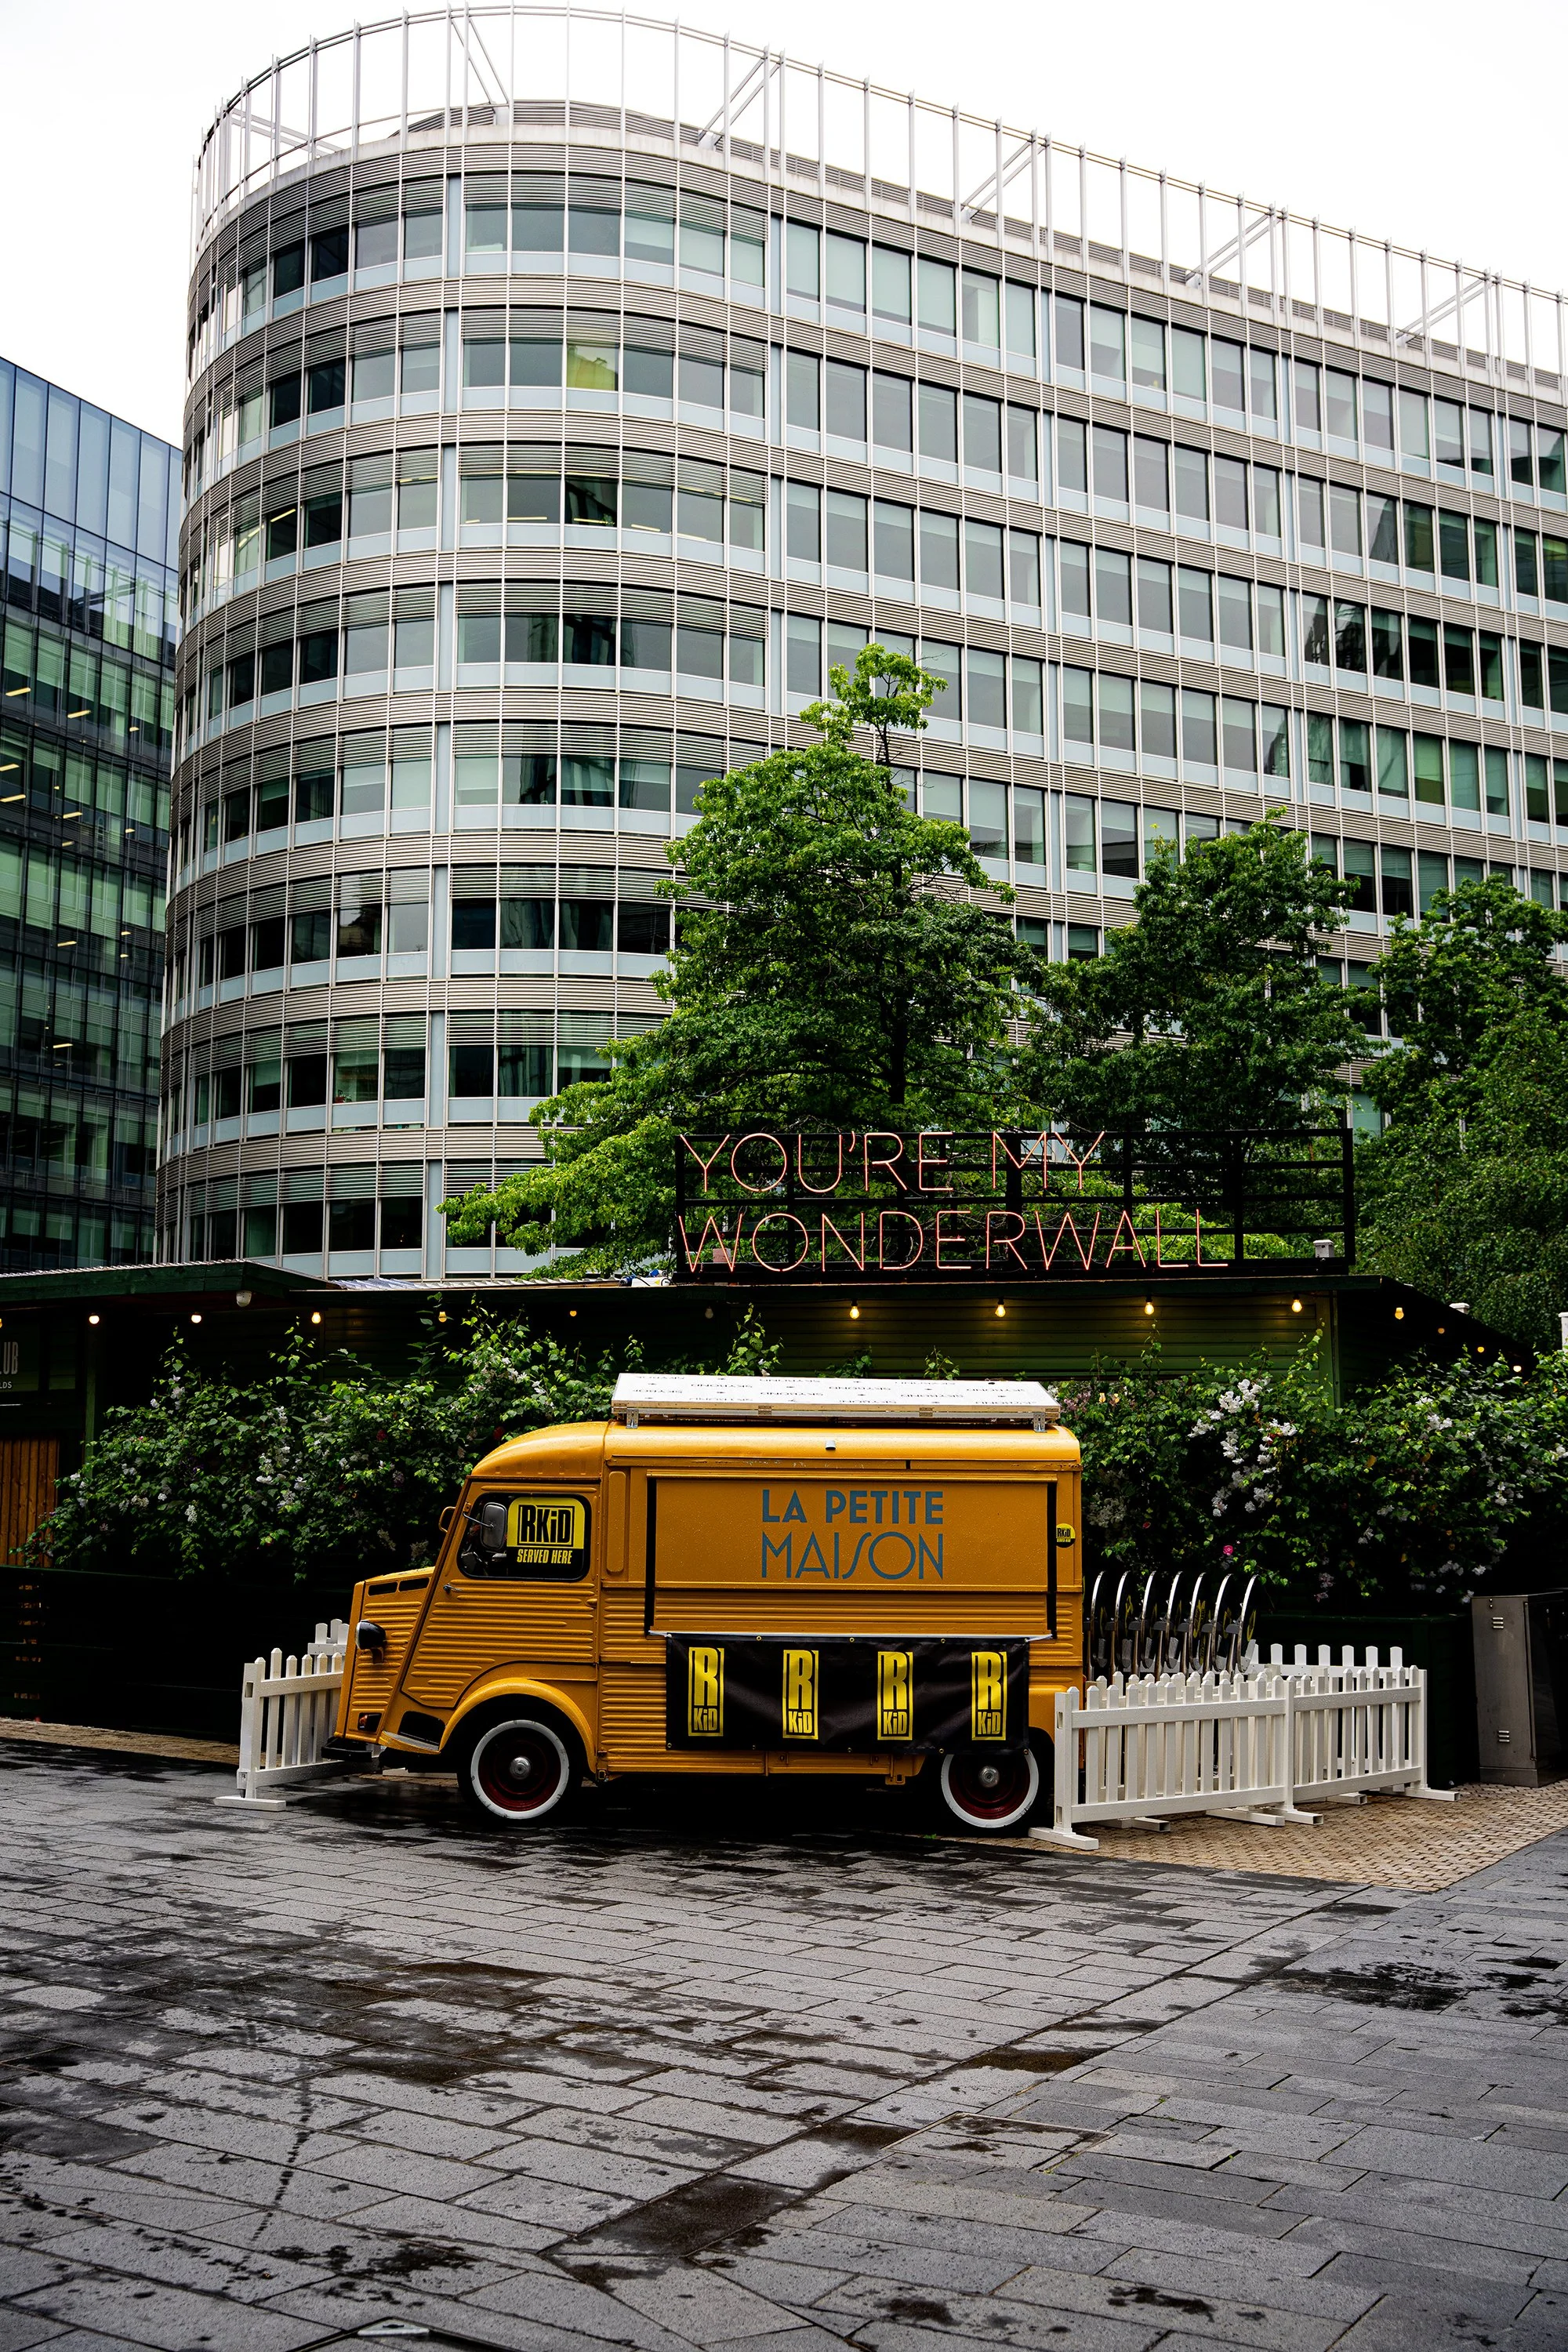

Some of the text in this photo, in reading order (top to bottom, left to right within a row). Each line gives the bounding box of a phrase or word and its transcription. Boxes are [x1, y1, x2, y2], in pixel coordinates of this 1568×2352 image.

[679, 1131, 1105, 1193] YOU'RE MY
[678, 1208, 1229, 1273] WONDERWALL
[0, 1342, 18, 1374] UB
[762, 1489, 944, 1524] LA PETITE
[517, 1549, 572, 1563] SERVED HERE
[761, 1531, 944, 1580] MAISON
